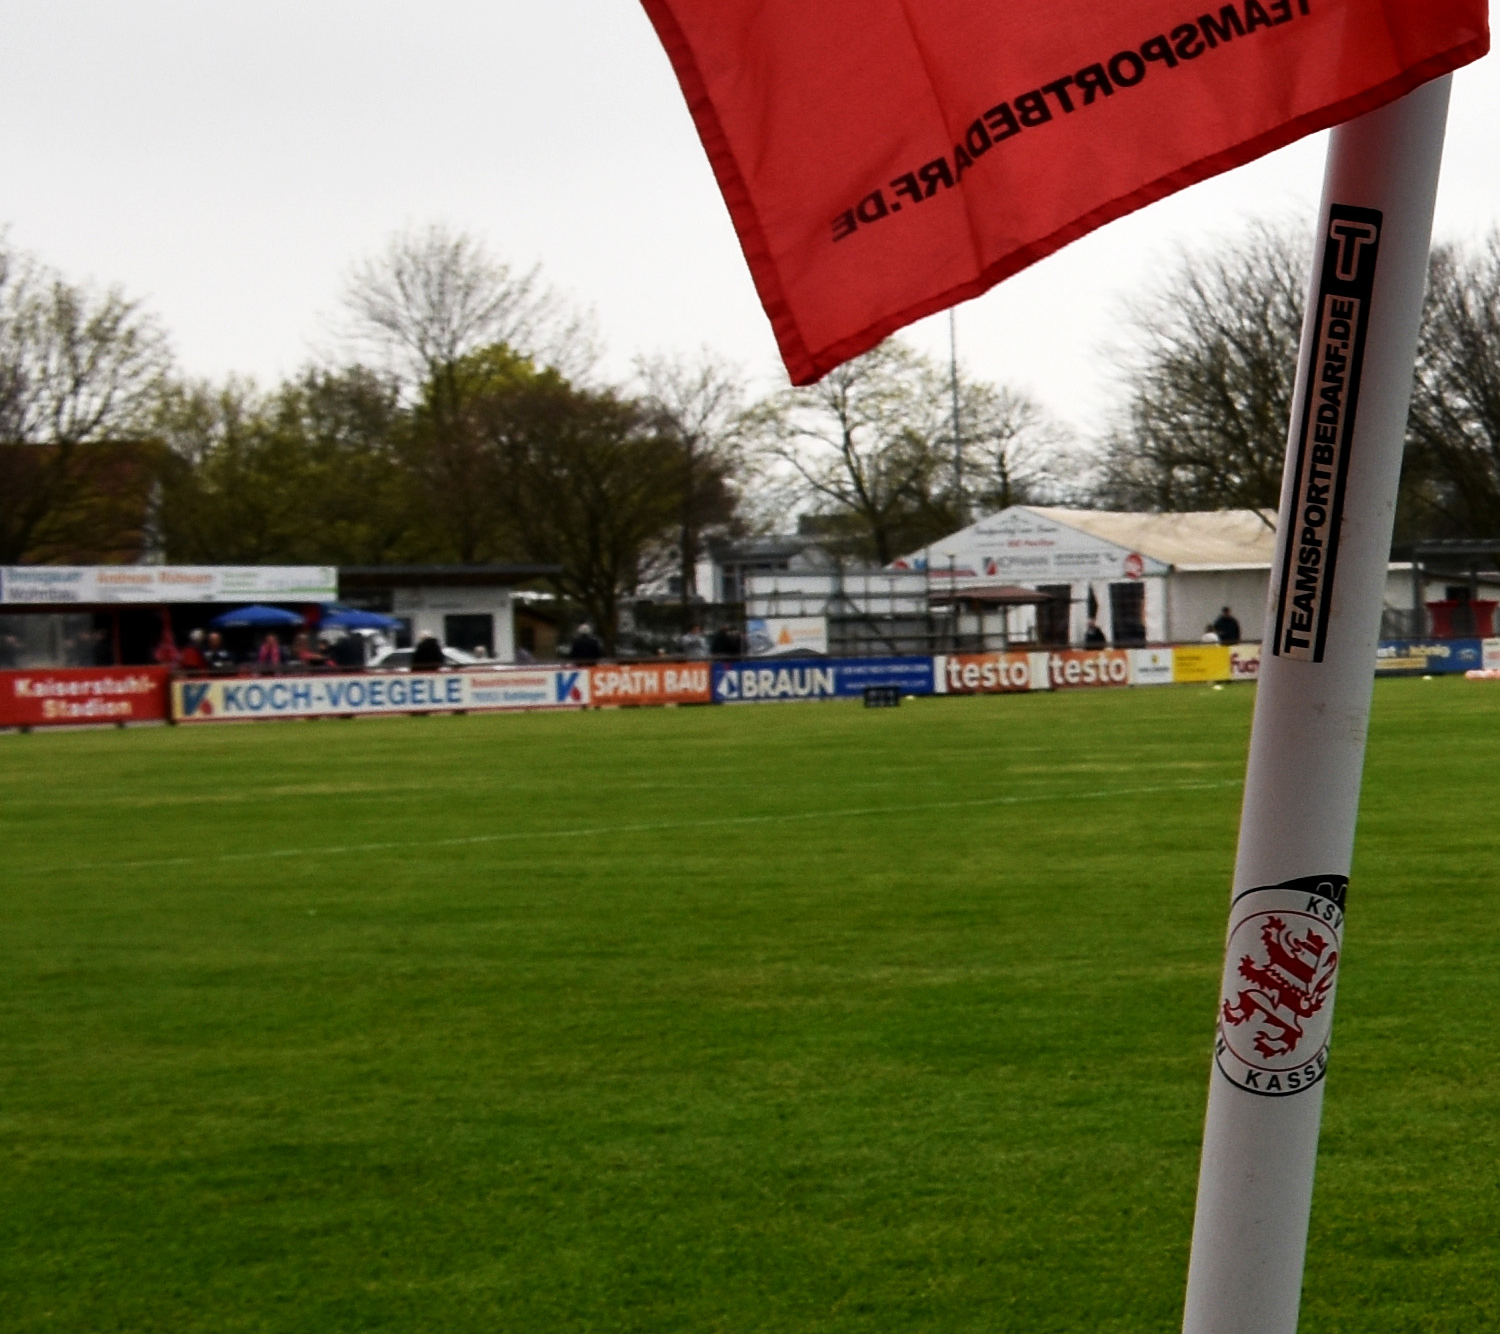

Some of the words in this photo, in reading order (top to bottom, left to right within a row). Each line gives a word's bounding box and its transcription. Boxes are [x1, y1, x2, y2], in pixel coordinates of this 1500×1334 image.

[1283, 296, 1357, 657] TEAMSPORTBEDARF.DE
[593, 666, 656, 698] SPÄTH
[663, 668, 708, 695] BAU
[741, 667, 835, 699] BRAUN
[946, 654, 1030, 690] testo
[1047, 651, 1130, 686] testo
[14, 675, 157, 699] Kaiserstuhl-
[223, 674, 463, 713] KOCH-VOEGELE
[42, 698, 133, 720] Stadion
[1305, 895, 1345, 930] KSV
